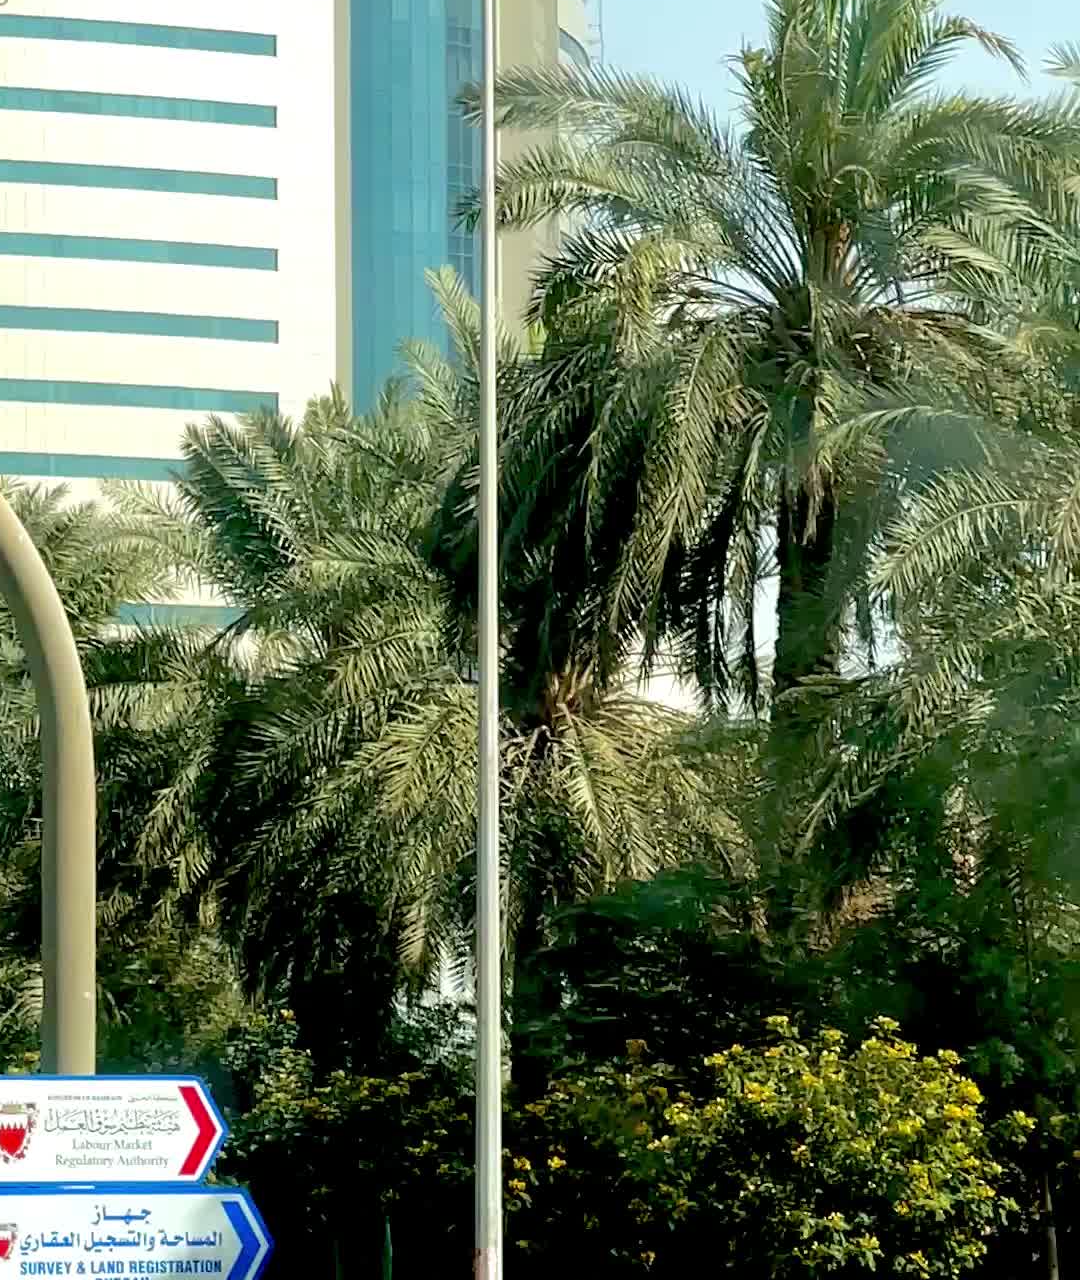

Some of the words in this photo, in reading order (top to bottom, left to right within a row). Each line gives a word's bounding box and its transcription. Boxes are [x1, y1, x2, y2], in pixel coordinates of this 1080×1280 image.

[72, 1138, 111, 1151] Labour
[114, 1138, 152, 1150] Market
[55, 1153, 113, 1168] Regulatory
[118, 1154, 169, 1168] Authority
[91, 1204, 152, 1225] جهاز
[20, 1230, 81, 1256] العقاري
[84, 1229, 156, 1252] والتسجيل
[159, 1229, 223, 1247] المساحة
[20, 1261, 72, 1275] SURVEY
[76, 1261, 86, 1275] &
[90, 1261, 124, 1274] LAND
[129, 1260, 223, 1274] REGISTRATION
